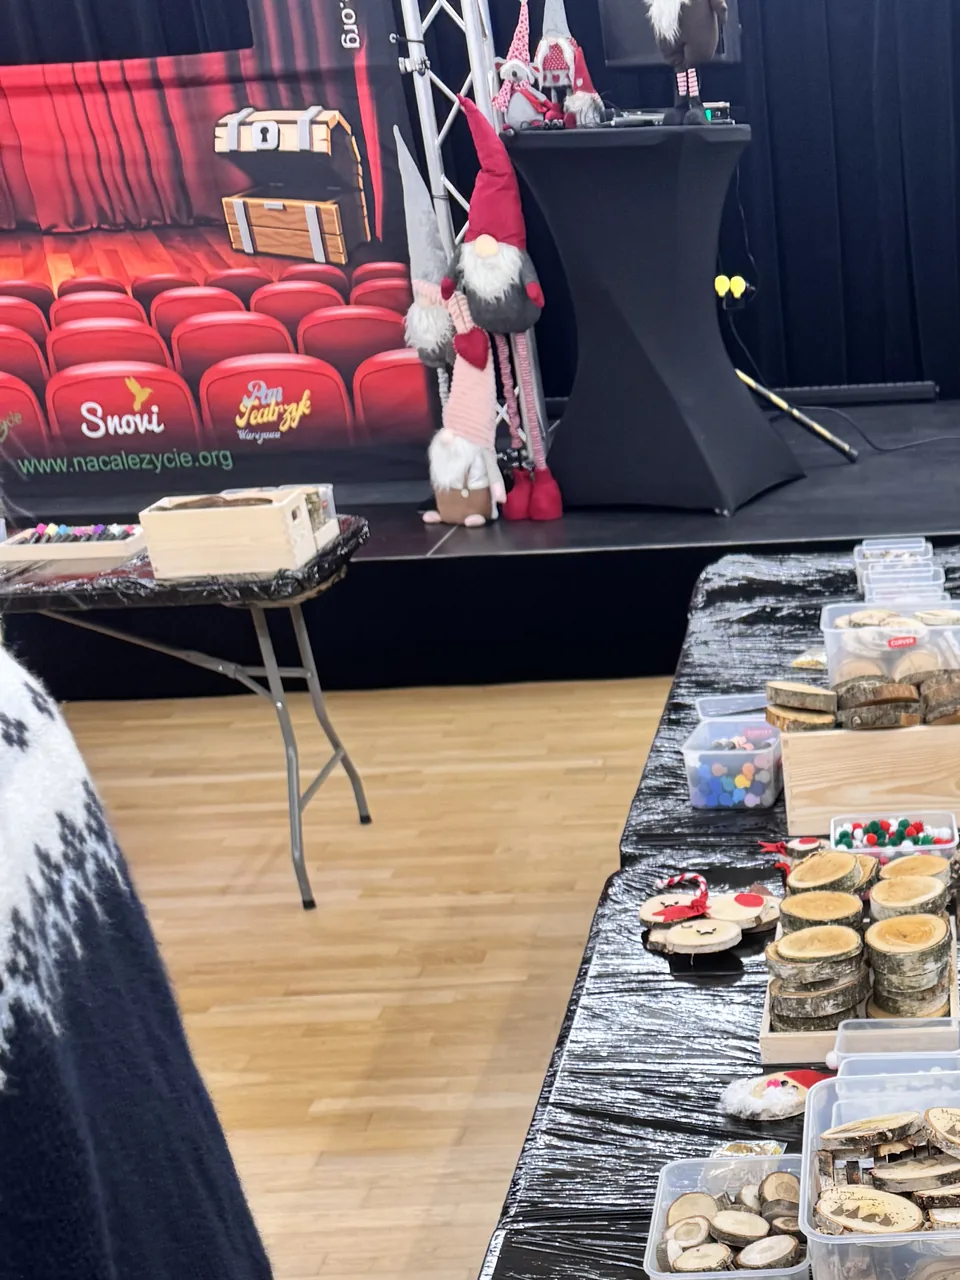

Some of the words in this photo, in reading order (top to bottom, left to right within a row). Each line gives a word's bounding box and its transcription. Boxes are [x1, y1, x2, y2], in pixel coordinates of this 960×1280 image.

[339, 0, 361, 49] .org
[80, 401, 165, 439] Snovi
[235, 389, 311, 432] Teatrzyk
[17, 447, 234, 475] www.nacalezycie.org
